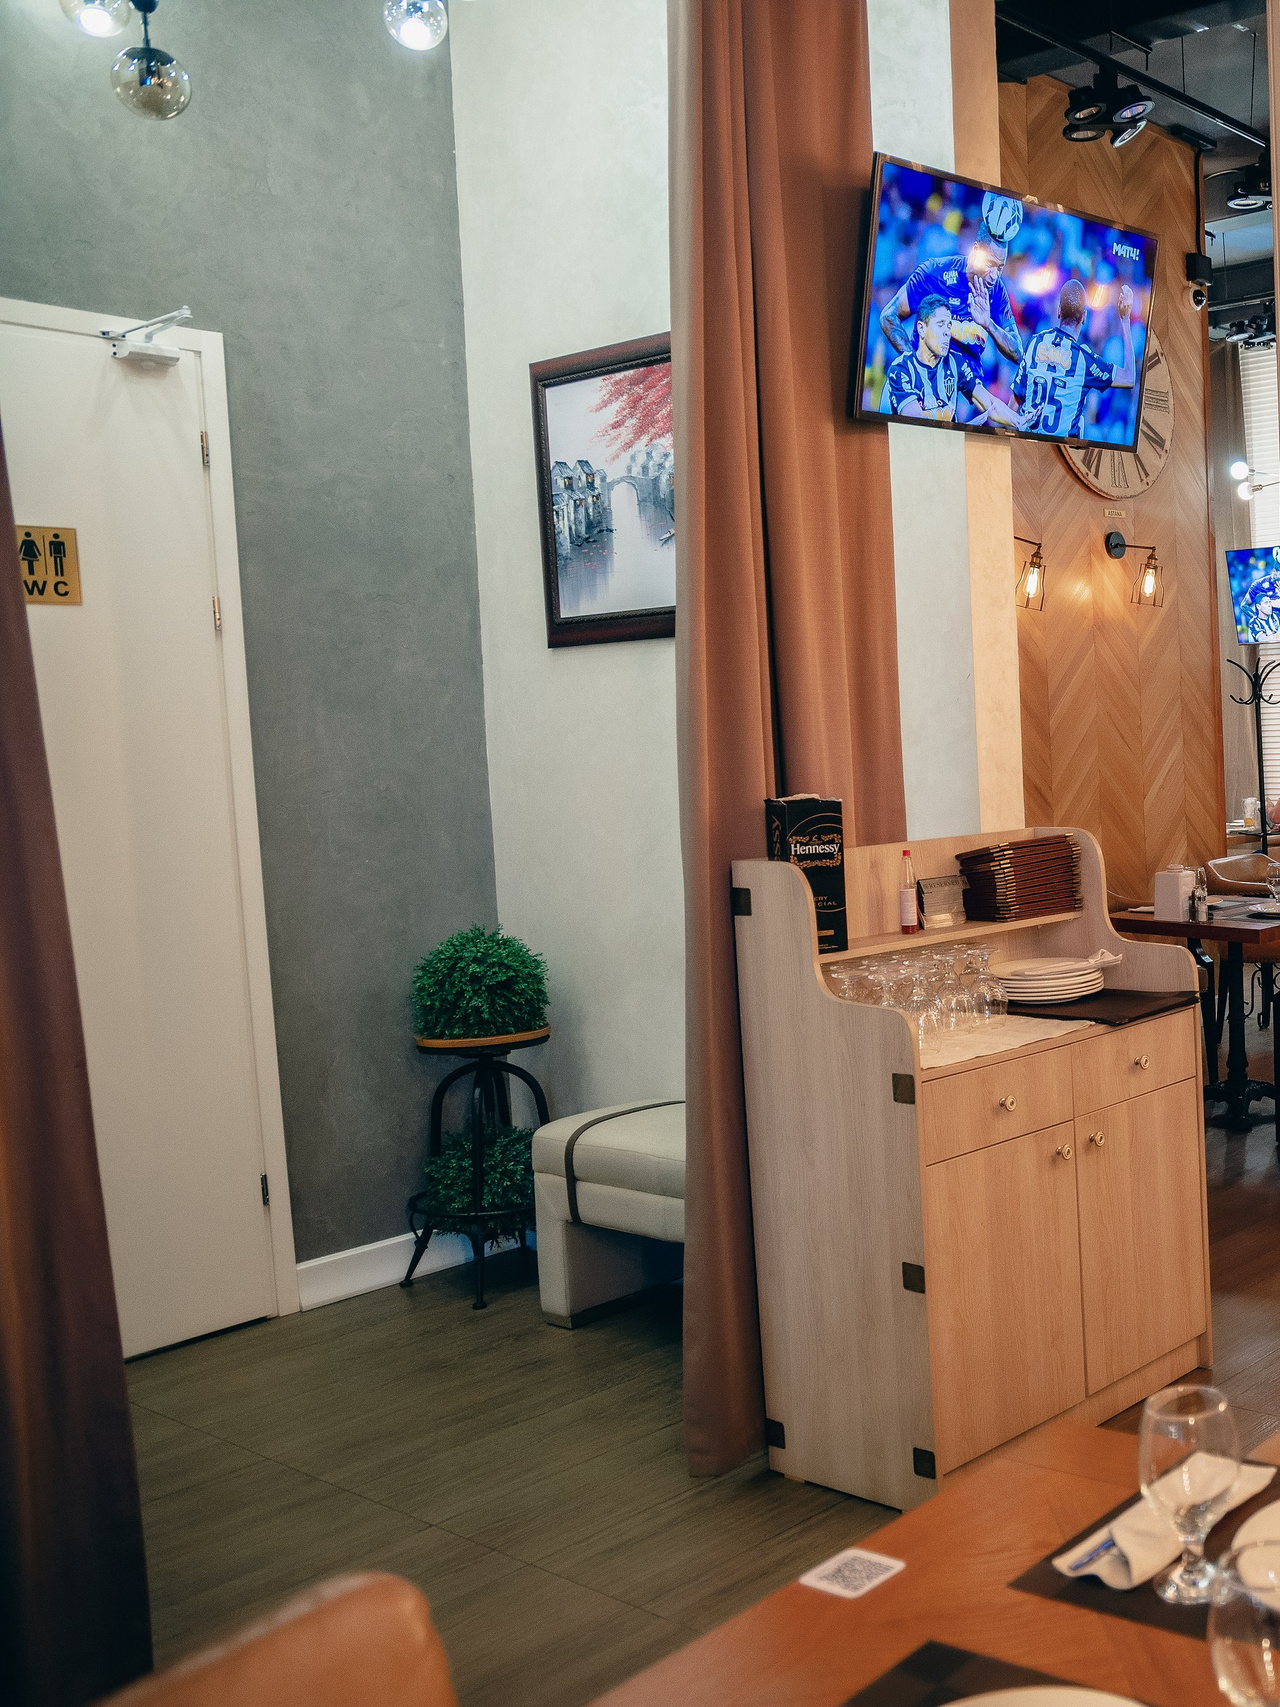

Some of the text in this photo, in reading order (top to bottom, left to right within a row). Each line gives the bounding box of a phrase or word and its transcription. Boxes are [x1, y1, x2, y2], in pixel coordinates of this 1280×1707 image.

[23, 579, 70, 597] WC
[791, 842, 840, 855] Hennessy
[928, 879, 960, 889] RESERVED
